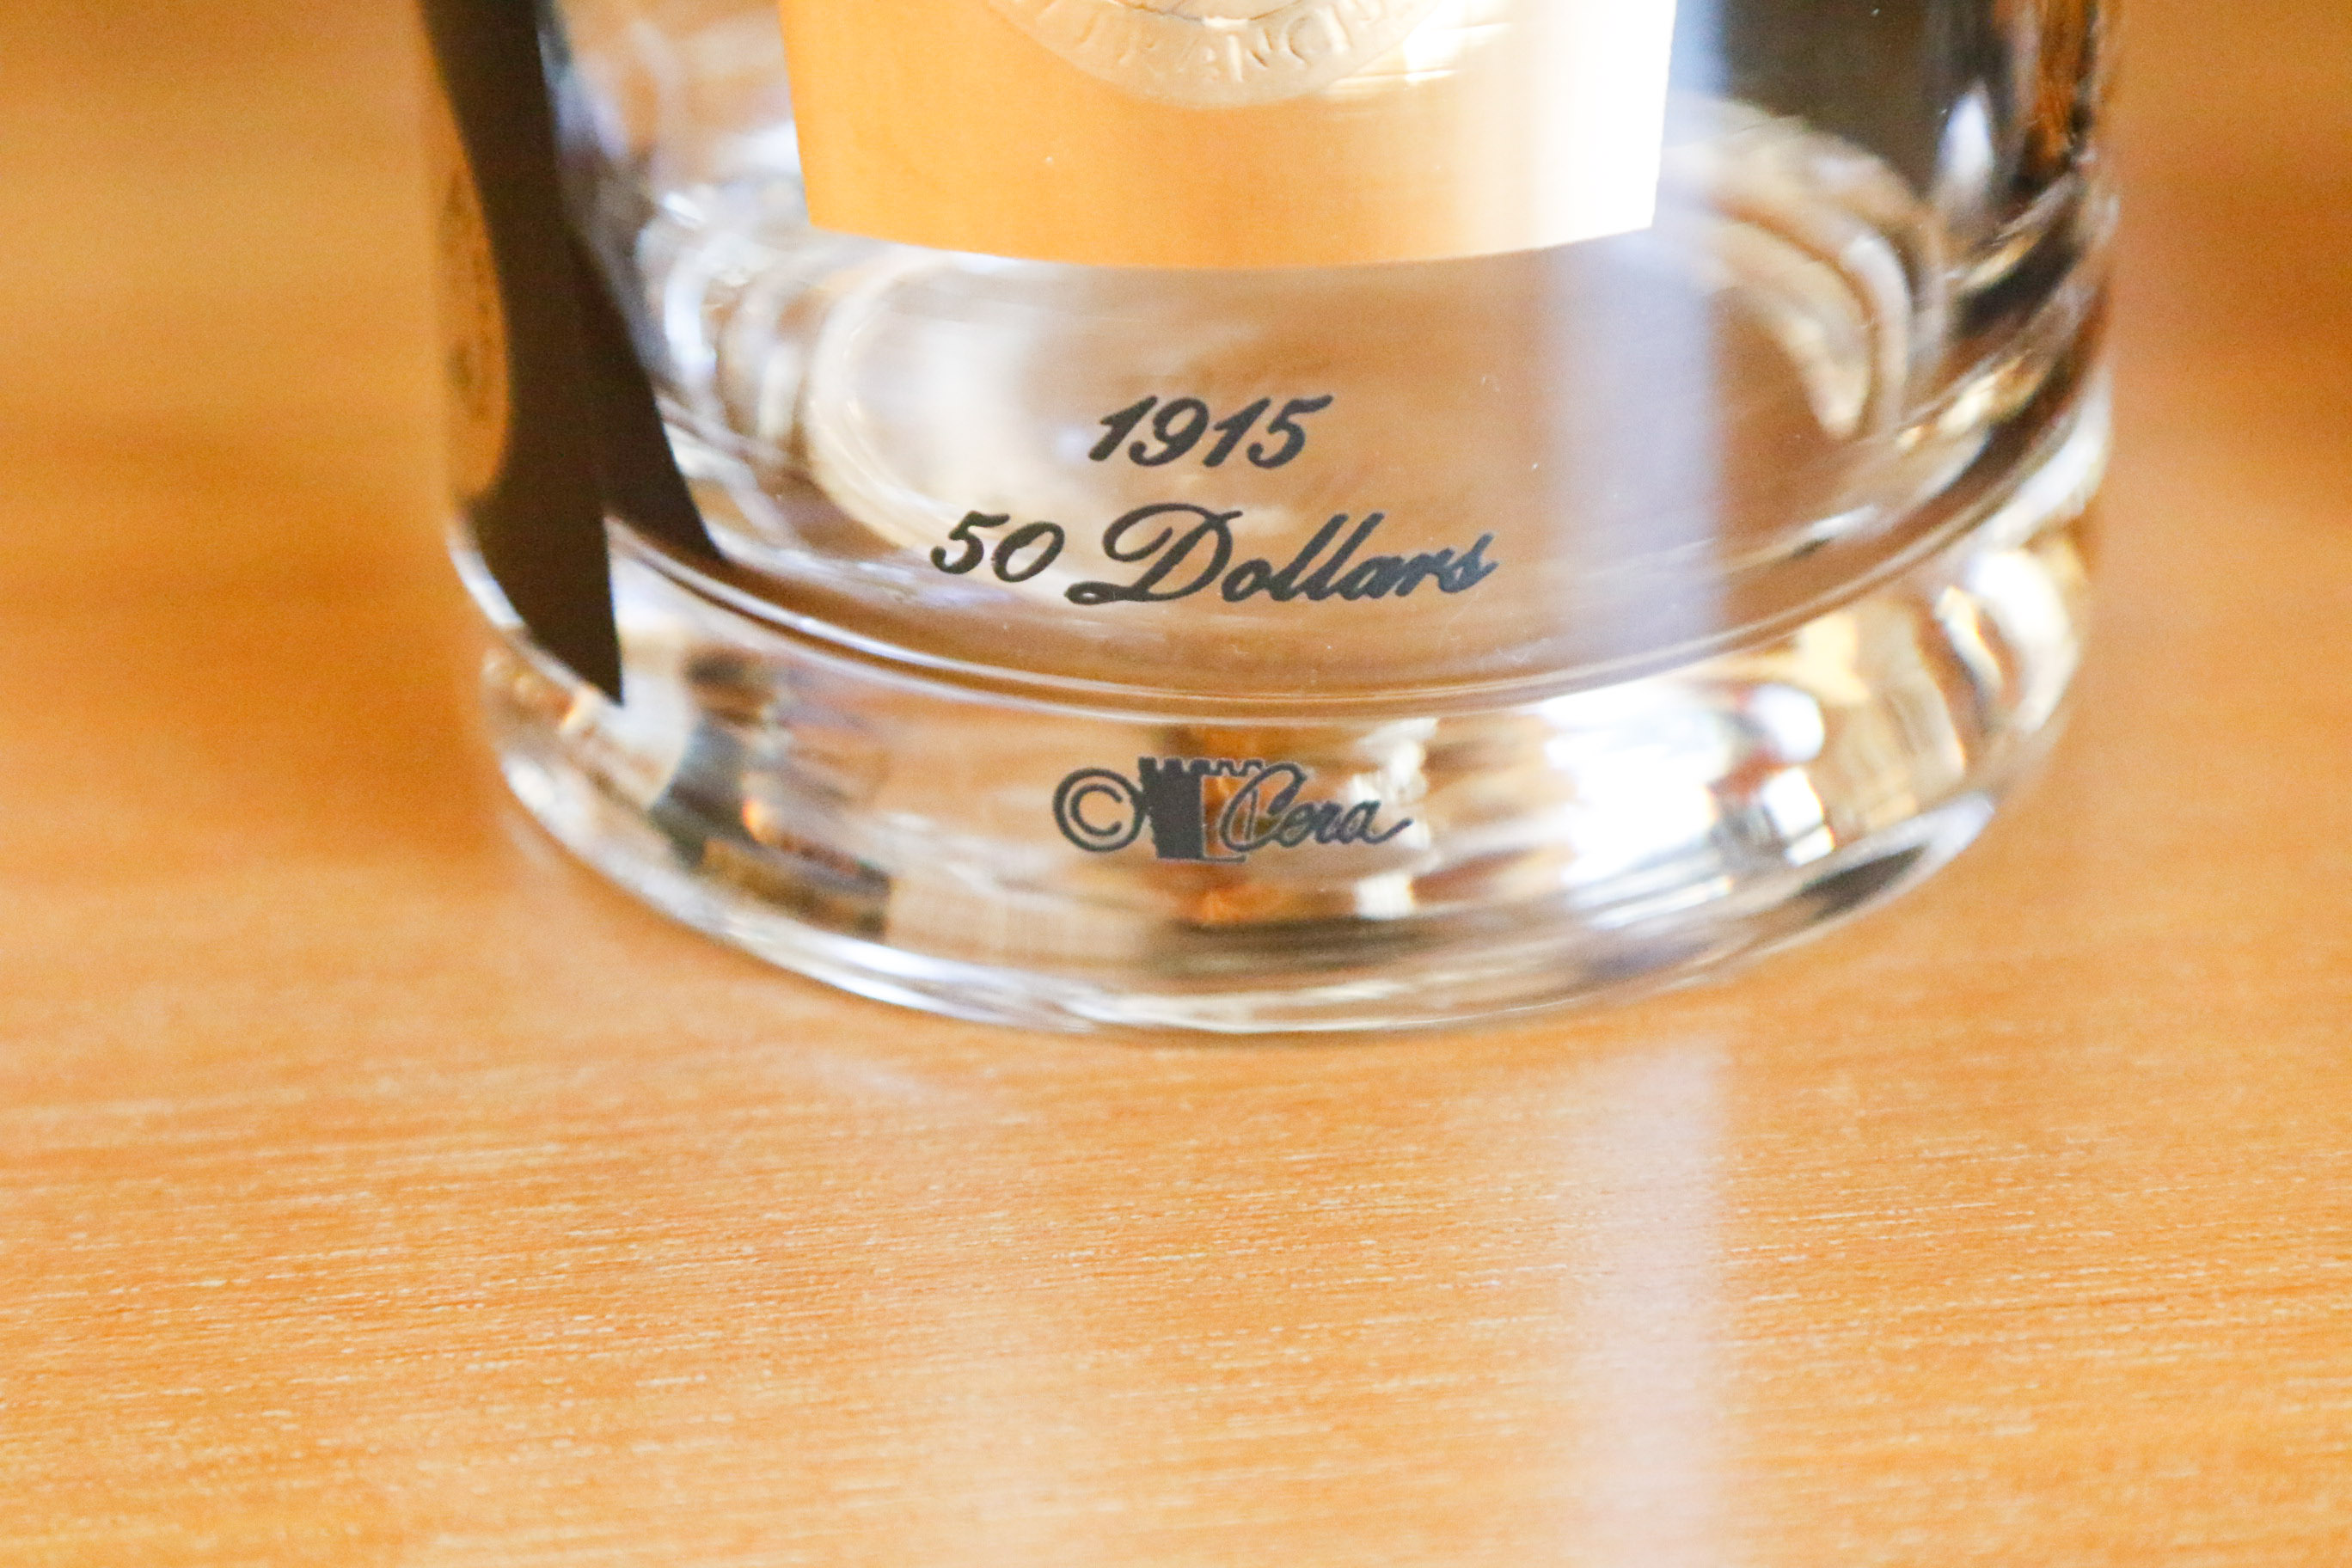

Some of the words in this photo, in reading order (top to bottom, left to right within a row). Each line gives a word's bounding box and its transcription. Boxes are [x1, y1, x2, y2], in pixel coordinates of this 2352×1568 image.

[1089, 395, 1333, 468] 1915
[930, 511, 1065, 582] 50
[1064, 503, 1498, 604] Dollars
[1219, 762, 1413, 853] Cora
